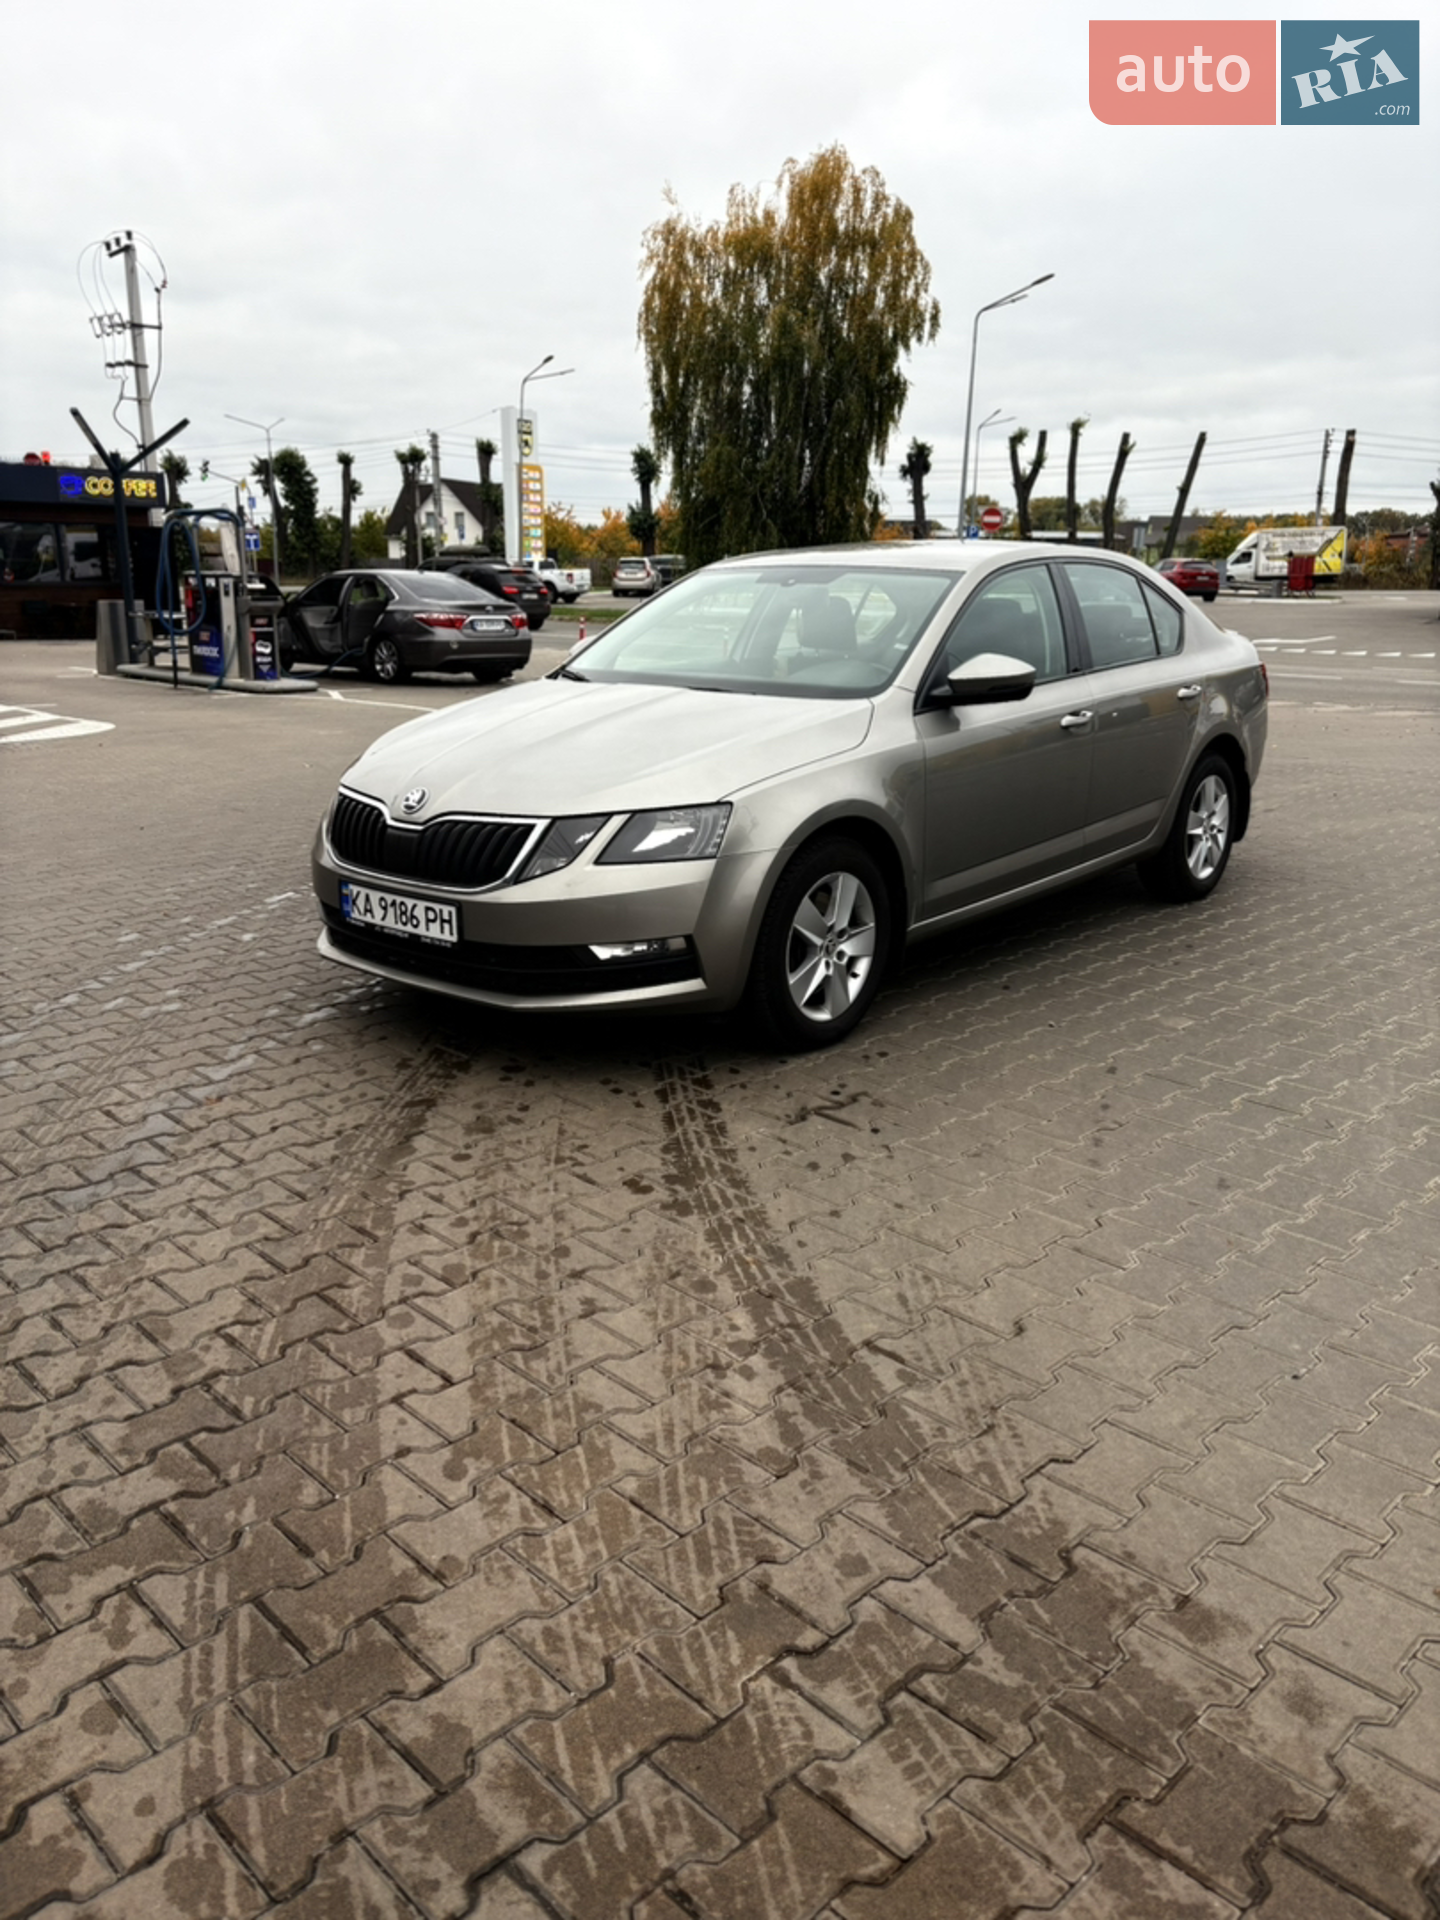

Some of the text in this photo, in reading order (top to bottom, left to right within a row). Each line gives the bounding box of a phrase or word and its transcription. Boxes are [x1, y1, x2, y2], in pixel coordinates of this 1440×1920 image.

[84, 475, 157, 499] COFEE
[351, 889, 455, 938] KA 9186 PH
